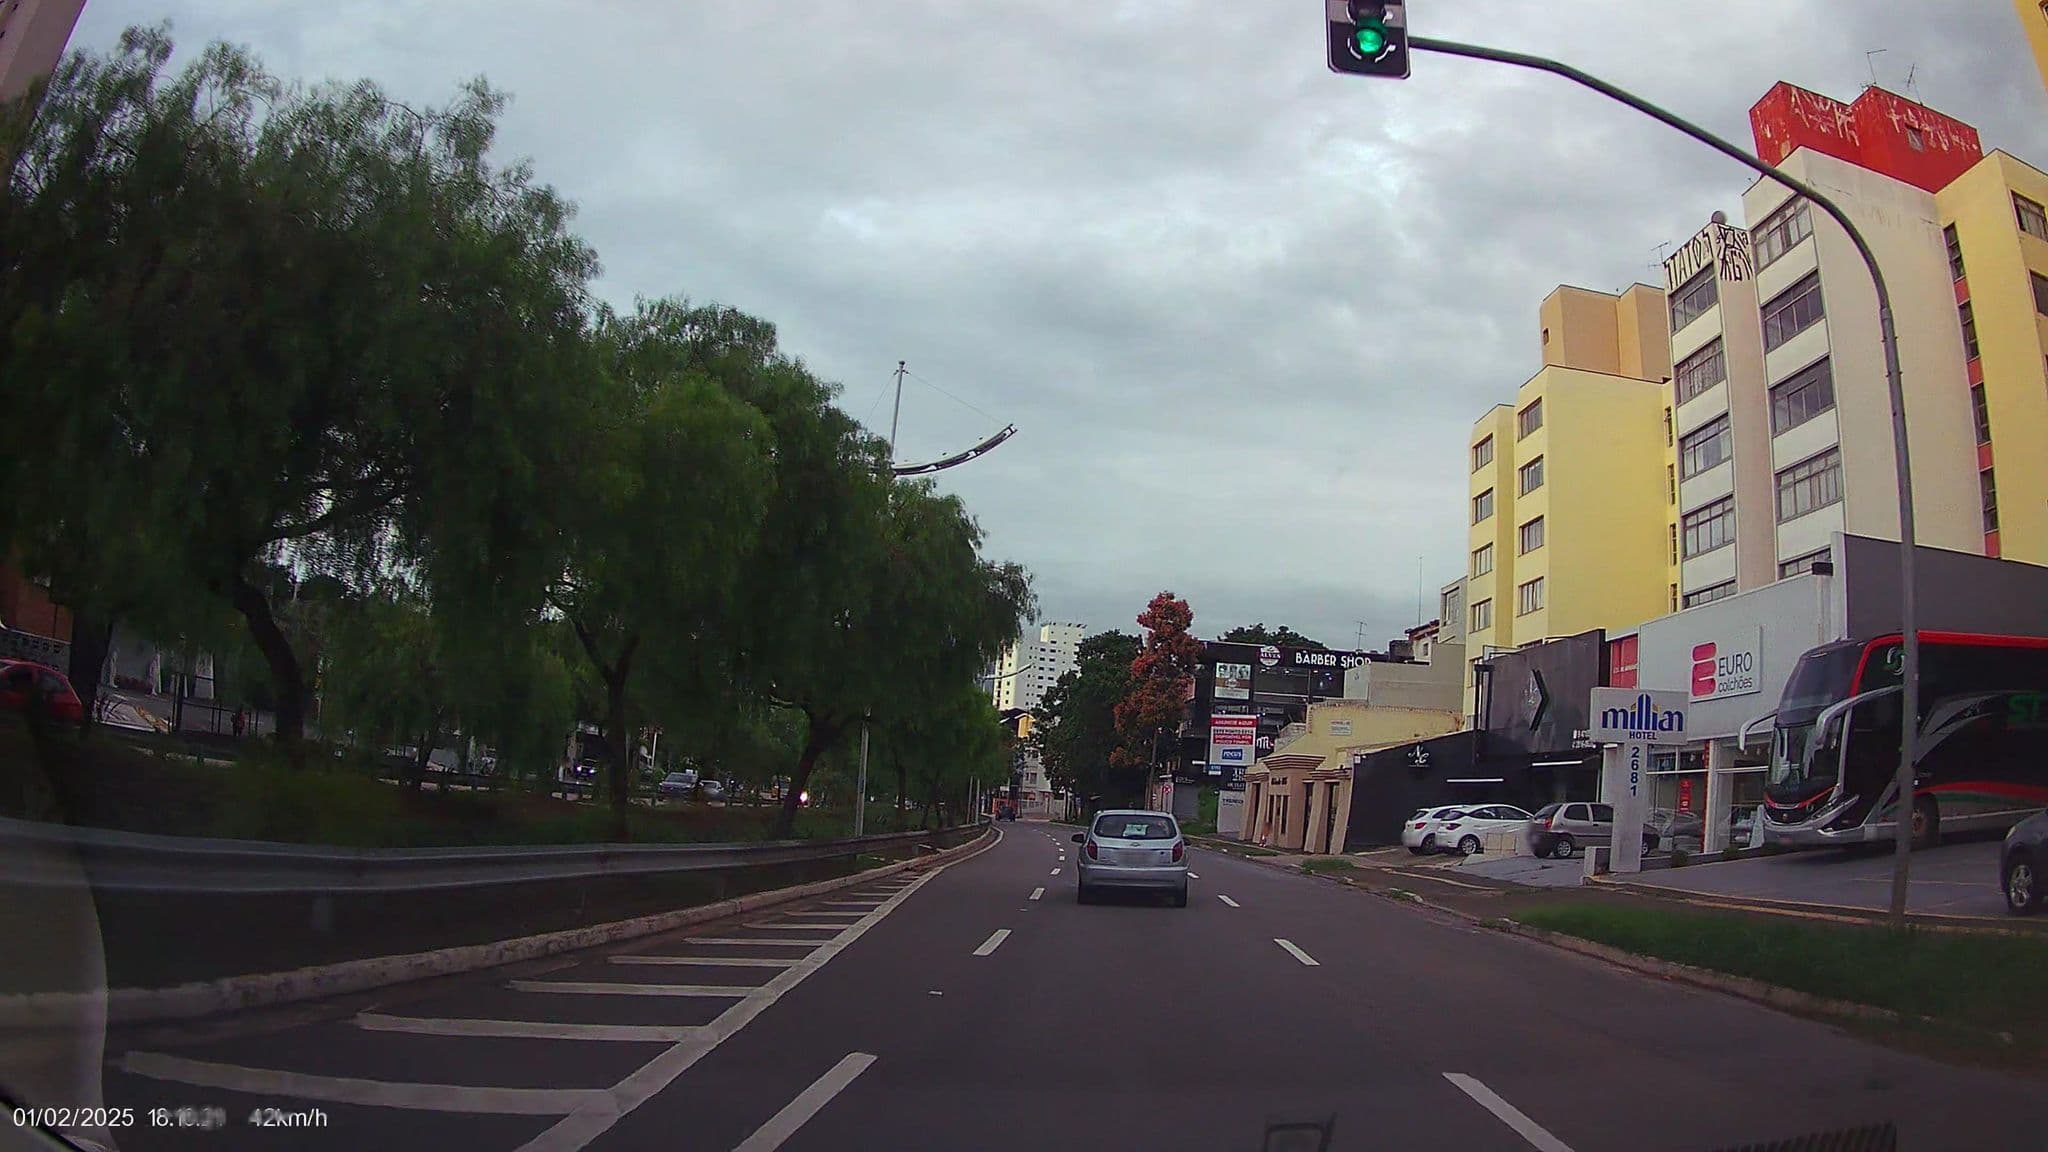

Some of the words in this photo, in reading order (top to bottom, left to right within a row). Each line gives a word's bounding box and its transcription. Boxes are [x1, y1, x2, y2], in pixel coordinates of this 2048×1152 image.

[1295, 652, 1337, 666] BARBER
[1340, 655, 1372, 668] SHOP
[1718, 652, 1753, 677] EURO
[1718, 675, 1753, 693] colchões
[1602, 693, 1684, 732] millian
[1629, 731, 1657, 740] HOTEL
[1630, 746, 1641, 797] 2681
